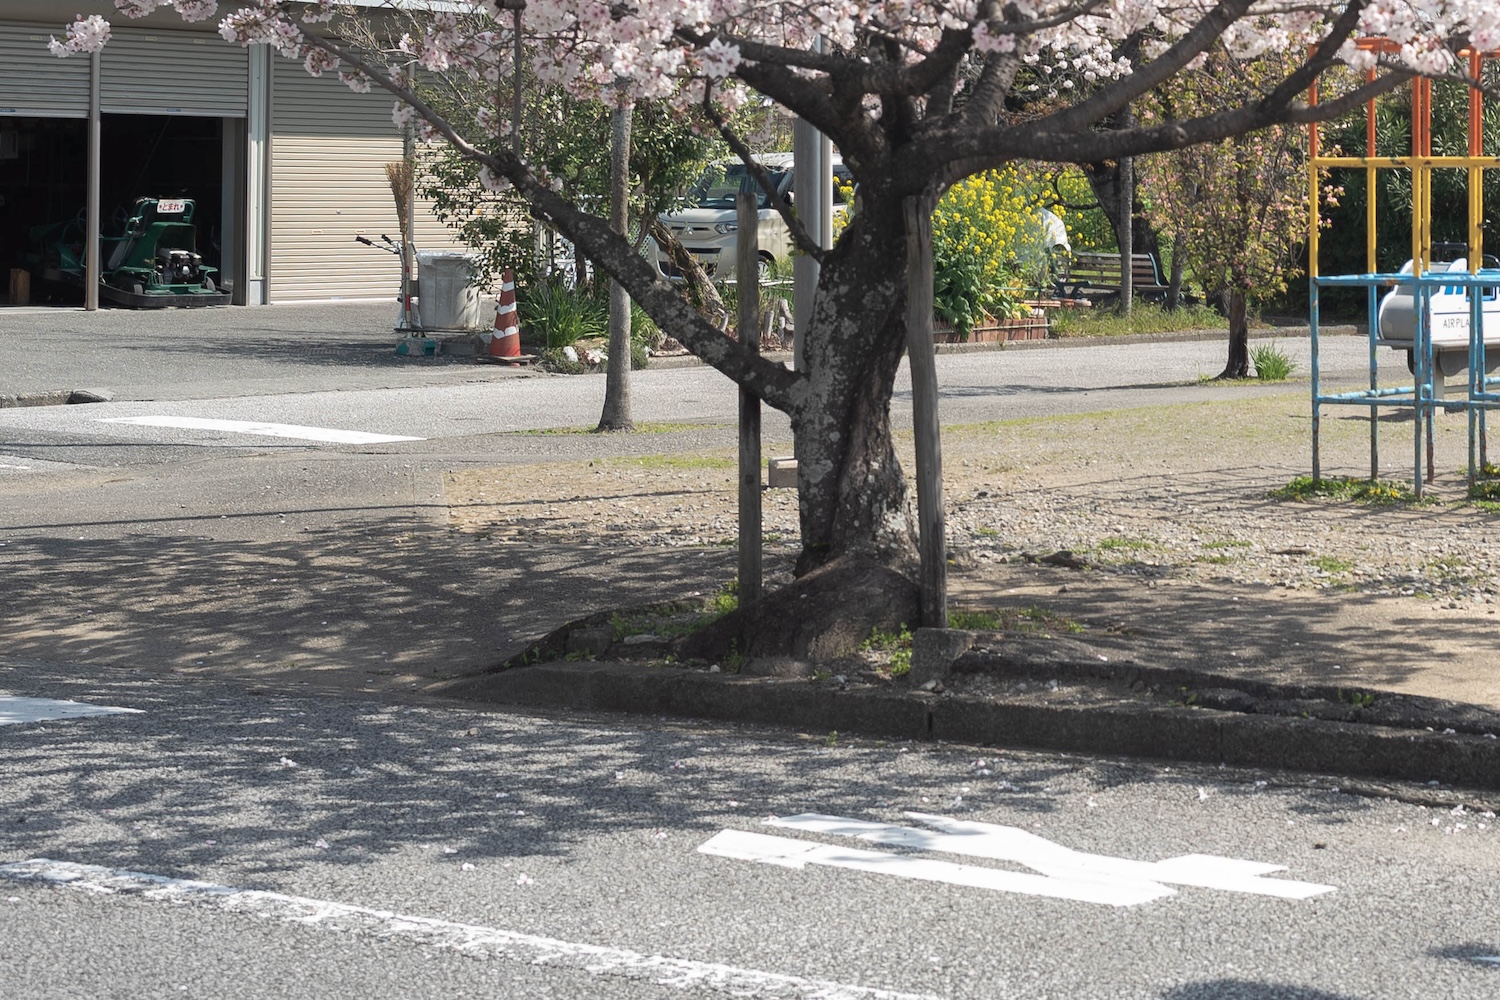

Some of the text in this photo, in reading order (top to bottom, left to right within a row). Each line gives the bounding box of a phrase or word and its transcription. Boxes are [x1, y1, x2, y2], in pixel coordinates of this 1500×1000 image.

[162, 203, 180, 211] とまれ
[1443, 318, 1470, 328] AIRPLA
